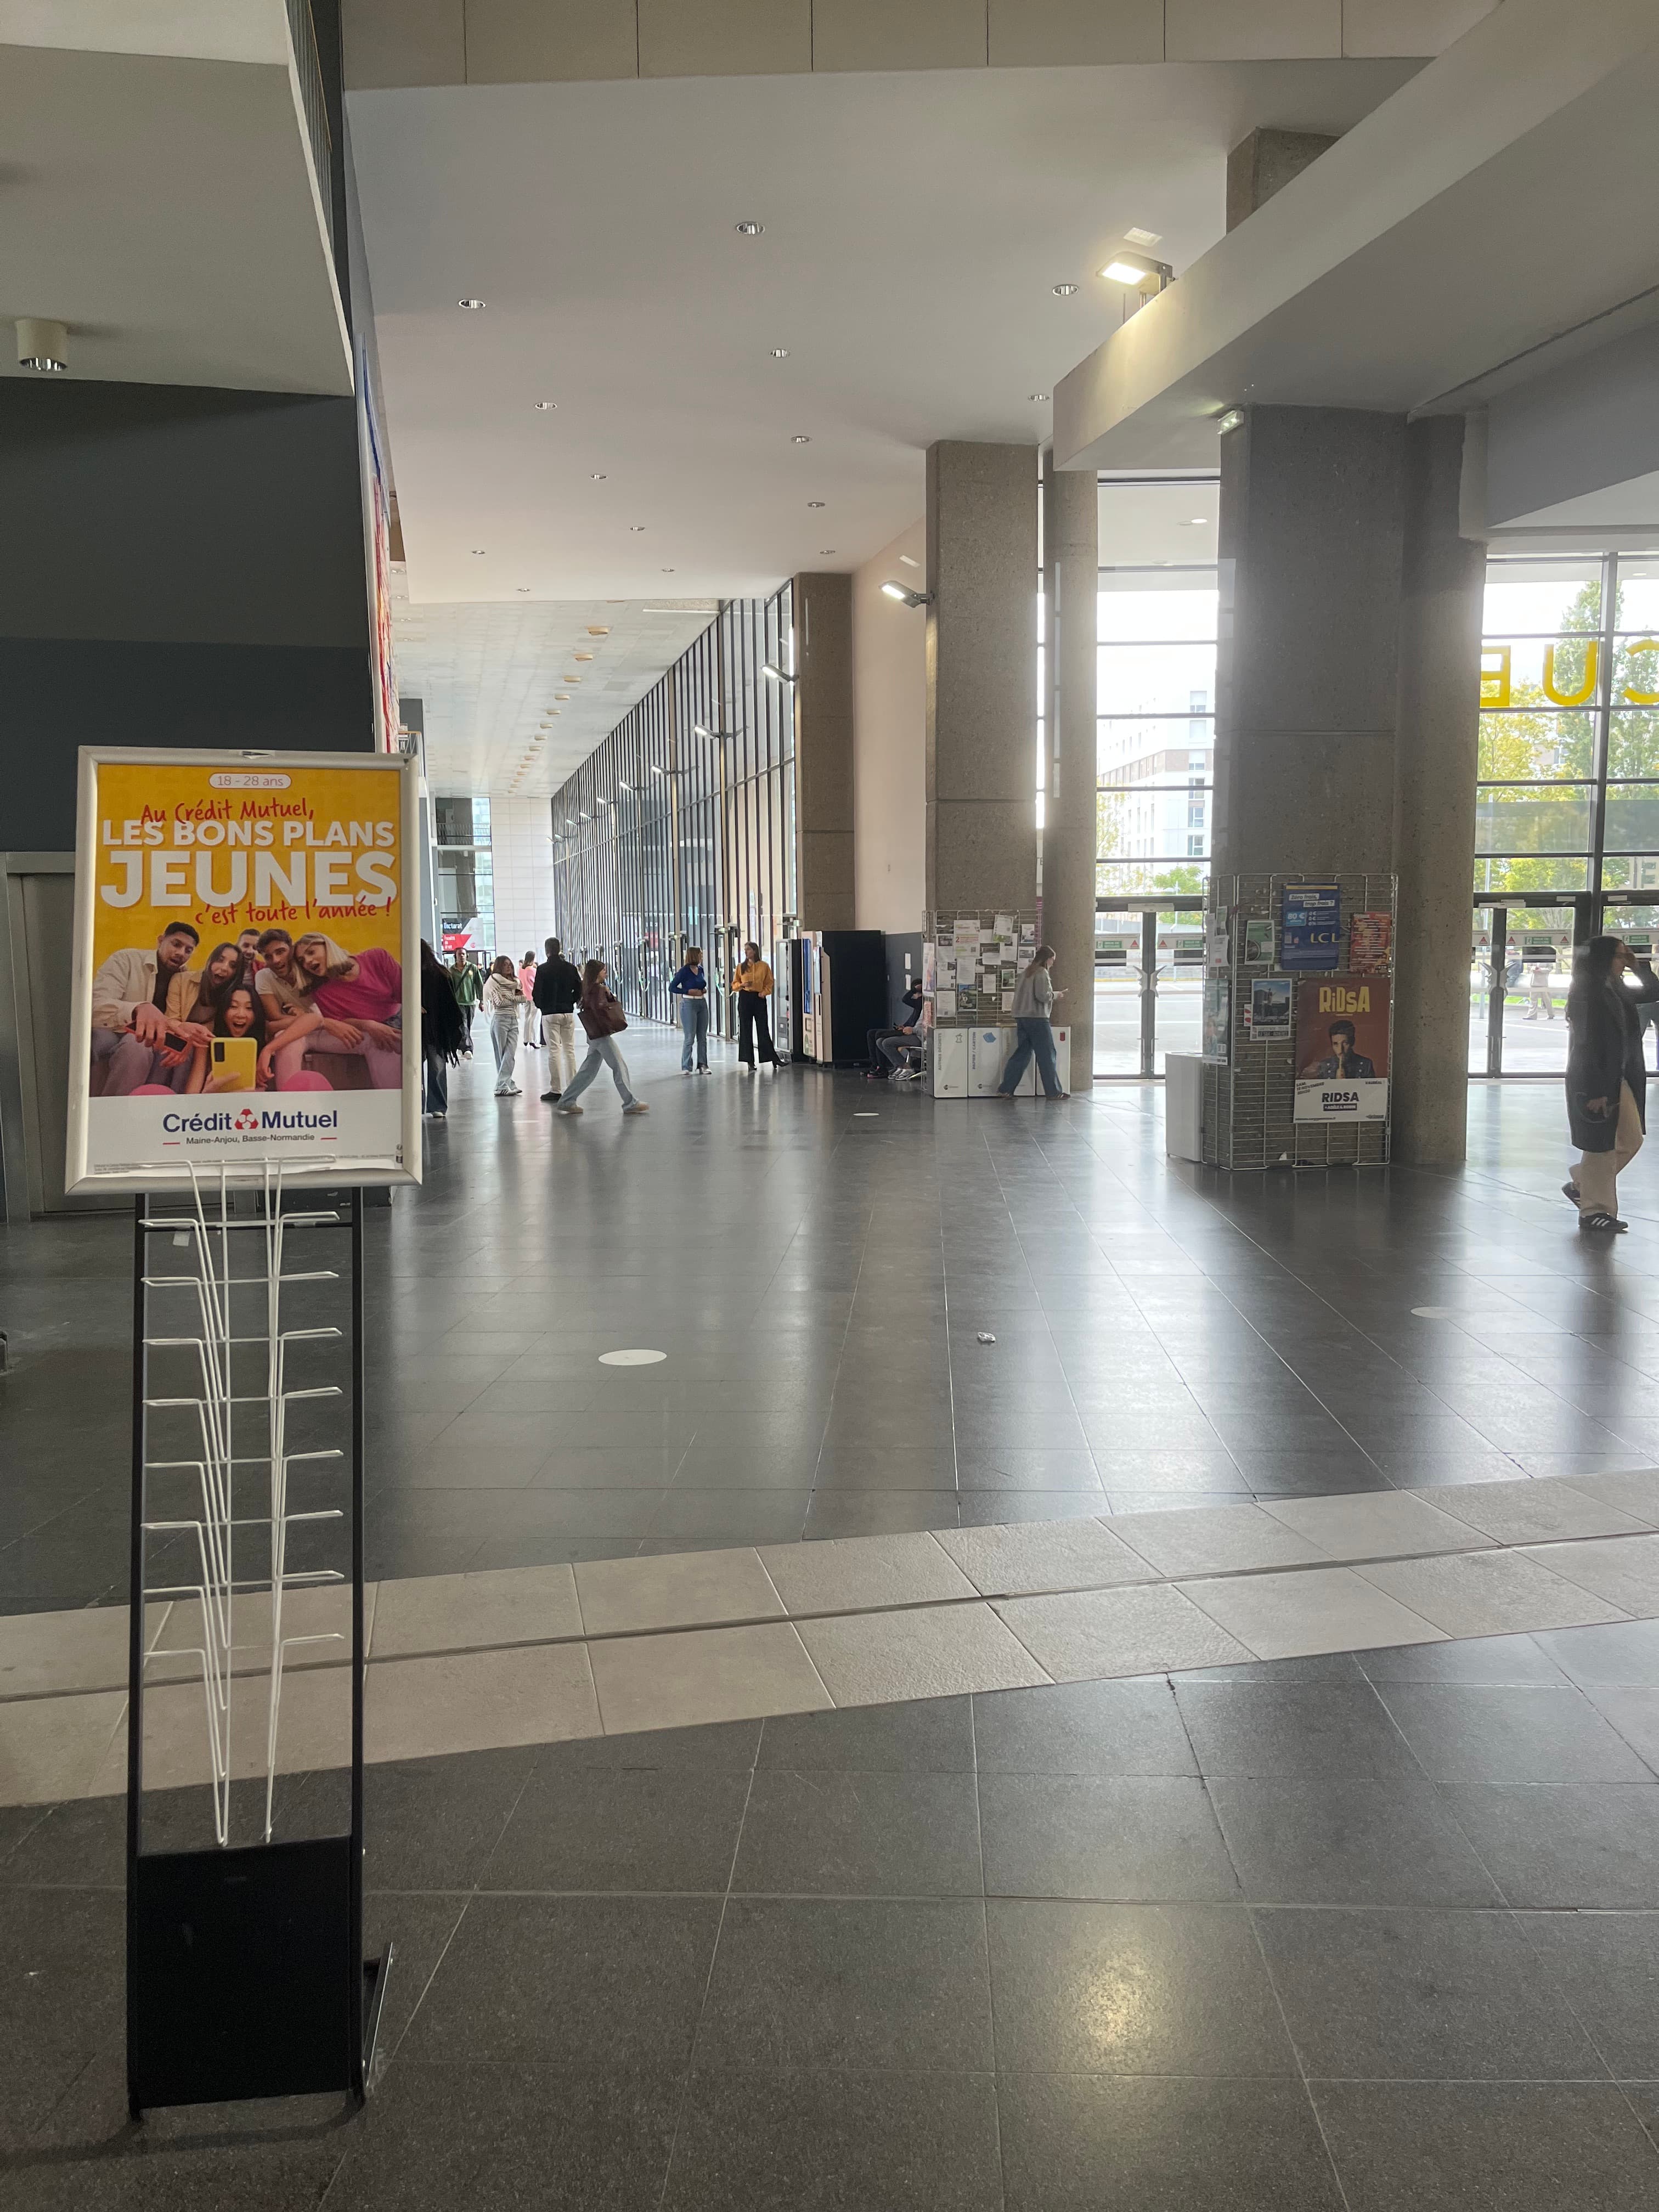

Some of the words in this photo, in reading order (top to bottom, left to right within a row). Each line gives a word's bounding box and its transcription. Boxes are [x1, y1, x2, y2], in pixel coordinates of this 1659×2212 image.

[217, 776, 232, 786] 18
[244, 776, 259, 786] 28
[263, 777, 284, 786] ans
[140, 804, 167, 824] Au
[174, 799, 233, 824] Crédit
[239, 797, 314, 820] Mutuel,
[103, 820, 164, 846] LES
[173, 820, 274, 847] BONS
[283, 820, 395, 847] PLANS
[100, 851, 398, 908] JEUNES
[195, 902, 238, 926] c'est
[246, 900, 298, 923] toute
[306, 895, 377, 920] l'année
[386, 896, 392, 917] !
[1310, 933, 1340, 943] LCL
[1322, 1092, 1359, 1103] RIDSA
[163, 1113, 232, 1132] Crédit
[262, 1110, 337, 1128] Mutuel
[242, 1134, 315, 1142] Basse-Normandie
